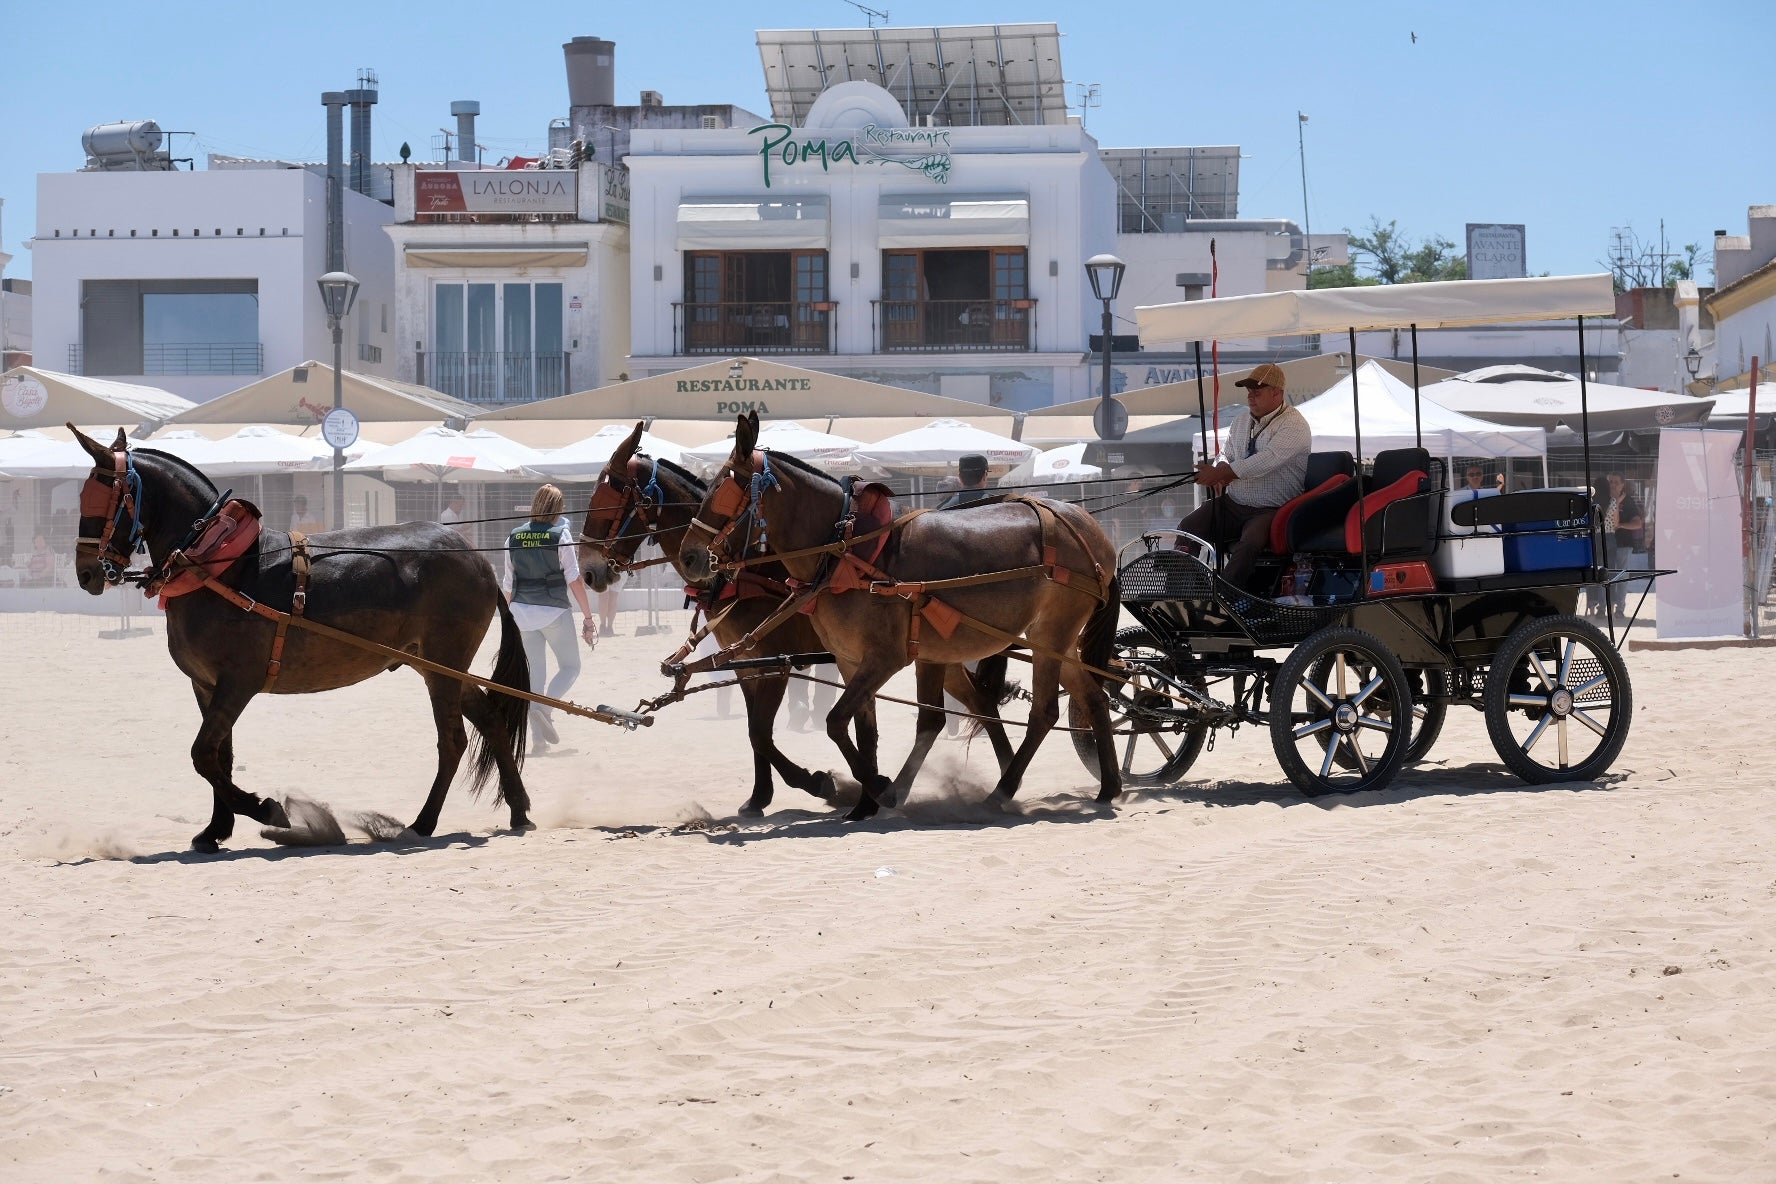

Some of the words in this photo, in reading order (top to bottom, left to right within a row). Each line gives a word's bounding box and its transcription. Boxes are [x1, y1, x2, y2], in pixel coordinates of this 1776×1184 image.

[864, 124, 950, 147] Restaurante
[474, 179, 566, 195] LALONJA
[1472, 240, 1520, 250] AVANTE
[1475, 252, 1517, 262] CLARO
[677, 378, 811, 393] RESTAURANTE
[716, 401, 769, 414] POMA
[515, 532, 550, 540] GUARDIA
[522, 540, 542, 548] CIVIL
